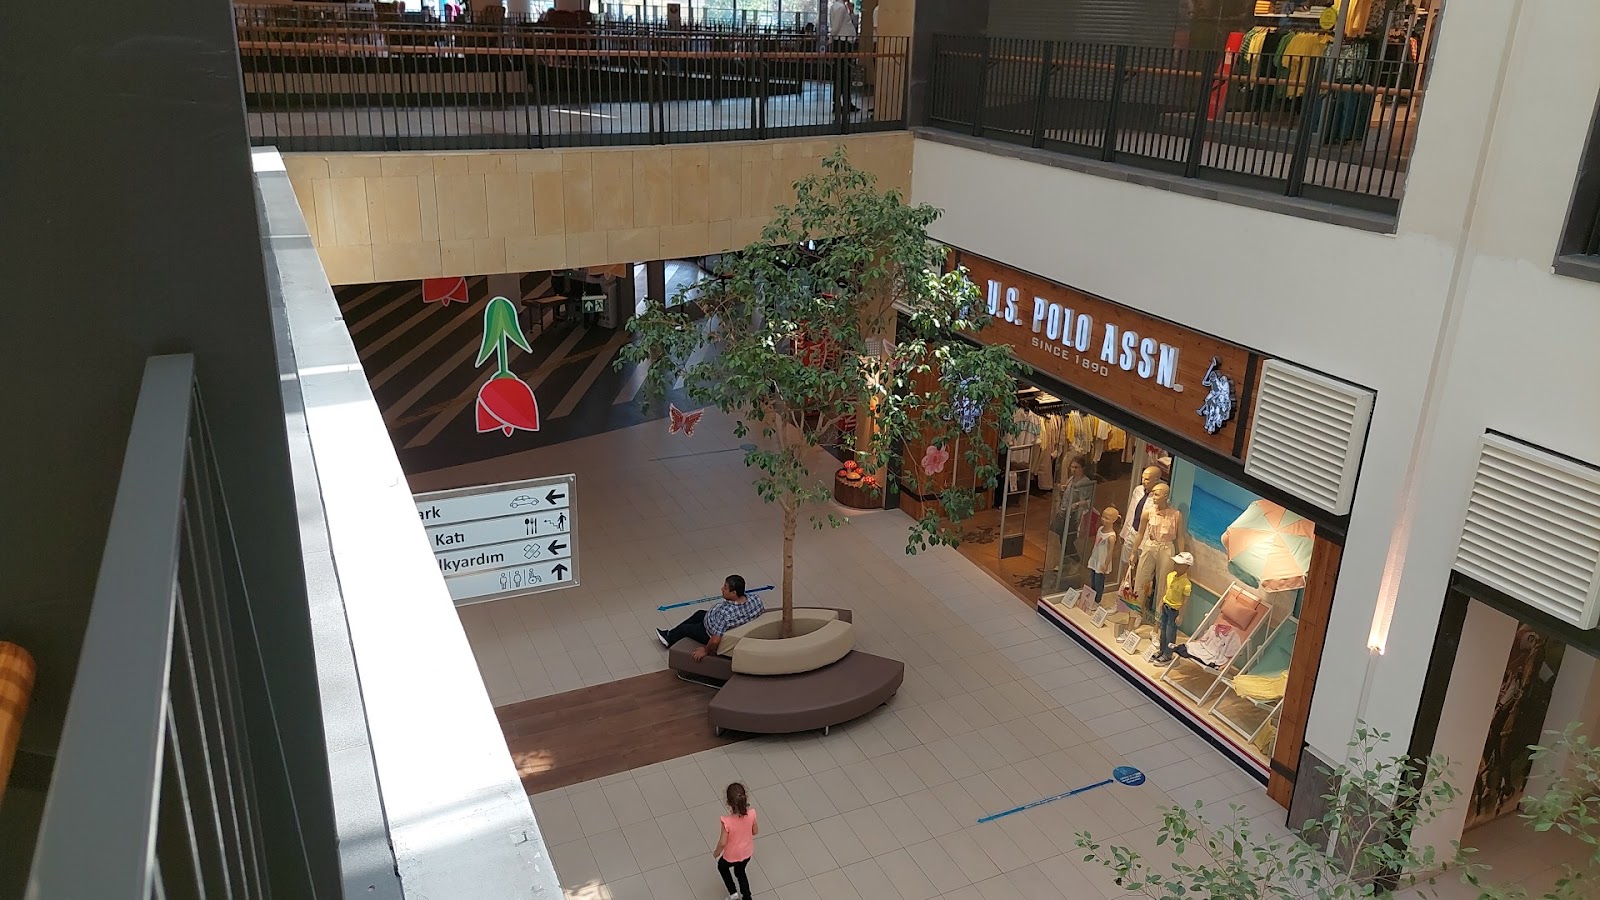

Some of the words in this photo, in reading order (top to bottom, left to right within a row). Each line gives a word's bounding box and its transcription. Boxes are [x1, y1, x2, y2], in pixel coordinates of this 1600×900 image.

[987, 279, 1023, 326] U.S.
[1031, 296, 1093, 352] POLO
[1100, 323, 1184, 393] ASSN.
[1031, 336, 1069, 360] SINCE
[1075, 354, 1108, 377] 1890
[435, 532, 465, 546] Katı
